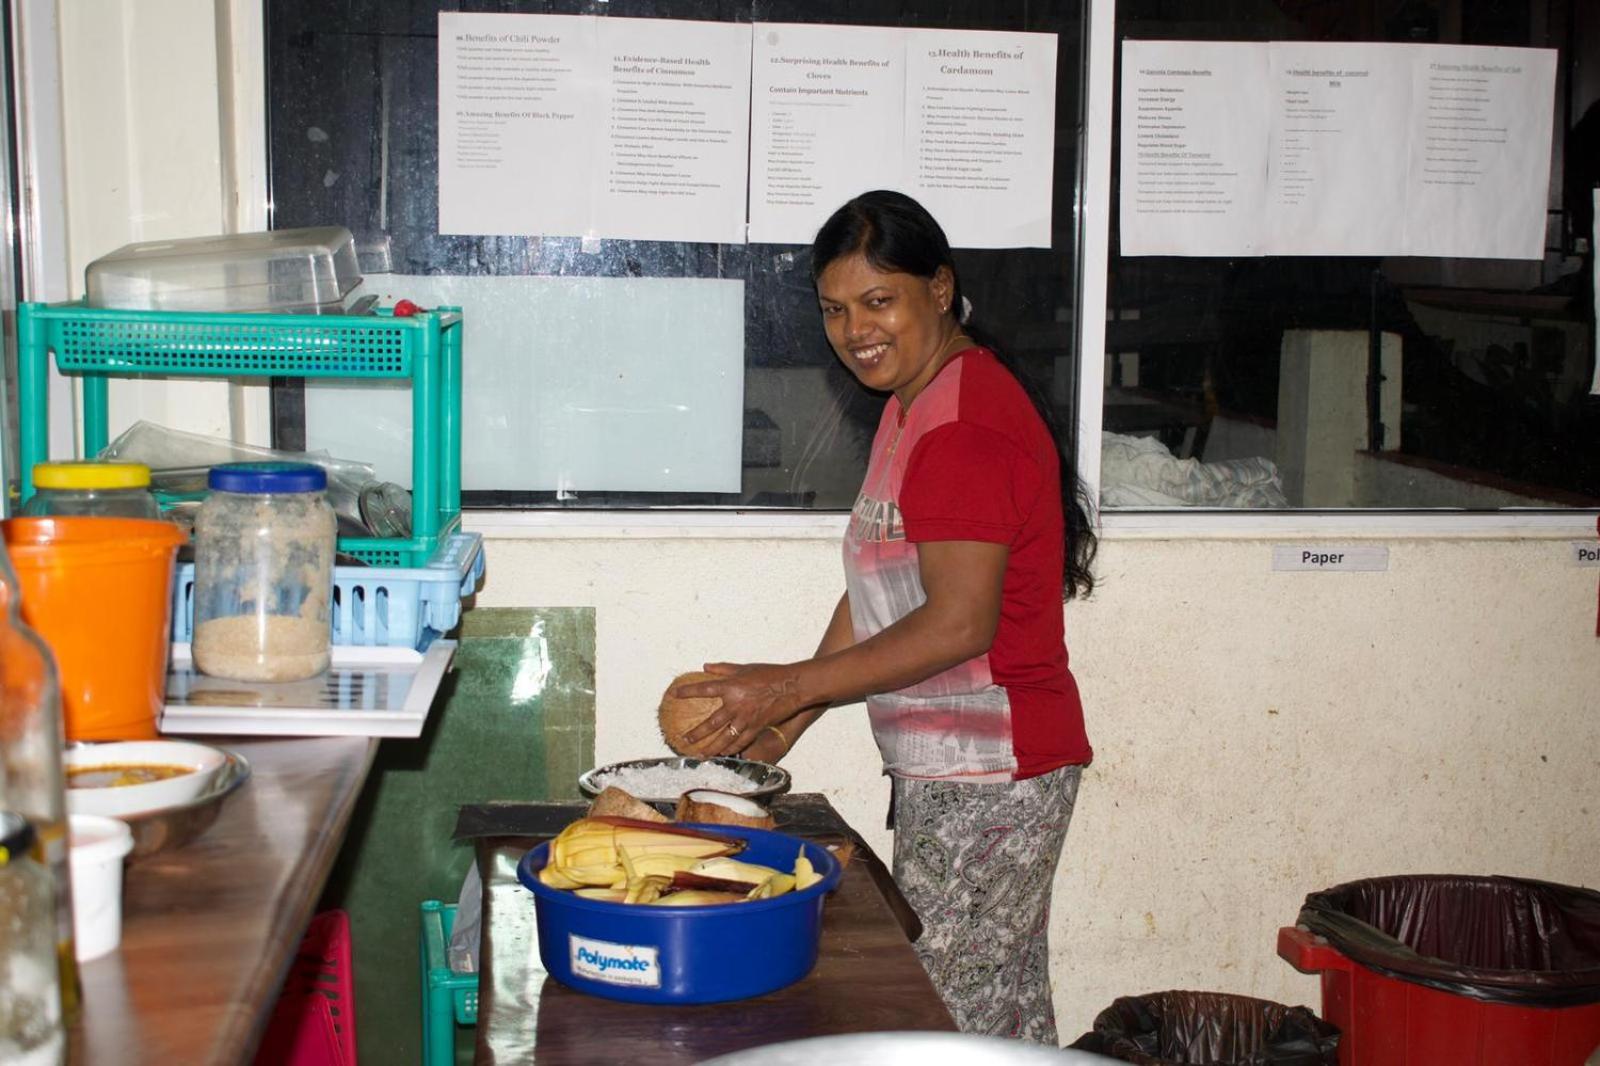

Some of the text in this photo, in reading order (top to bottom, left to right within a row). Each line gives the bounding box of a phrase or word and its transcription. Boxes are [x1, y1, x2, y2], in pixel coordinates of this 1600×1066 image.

[499, 35, 509, 43] of
[531, 35, 560, 44] Powder
[973, 50, 1012, 59] Benefits
[1013, 51, 1024, 60] of
[685, 58, 711, 66] Health
[823, 58, 848, 66] Health
[849, 59, 880, 67] Benefits
[613, 65, 695, 75] Benefits of Cinnamon
[940, 65, 993, 75] Cardamom
[798, 87, 834, 96] Important
[835, 88, 868, 96] Nutrients
[1302, 551, 1345, 566] Paper
[577, 947, 650, 971] Polymate
